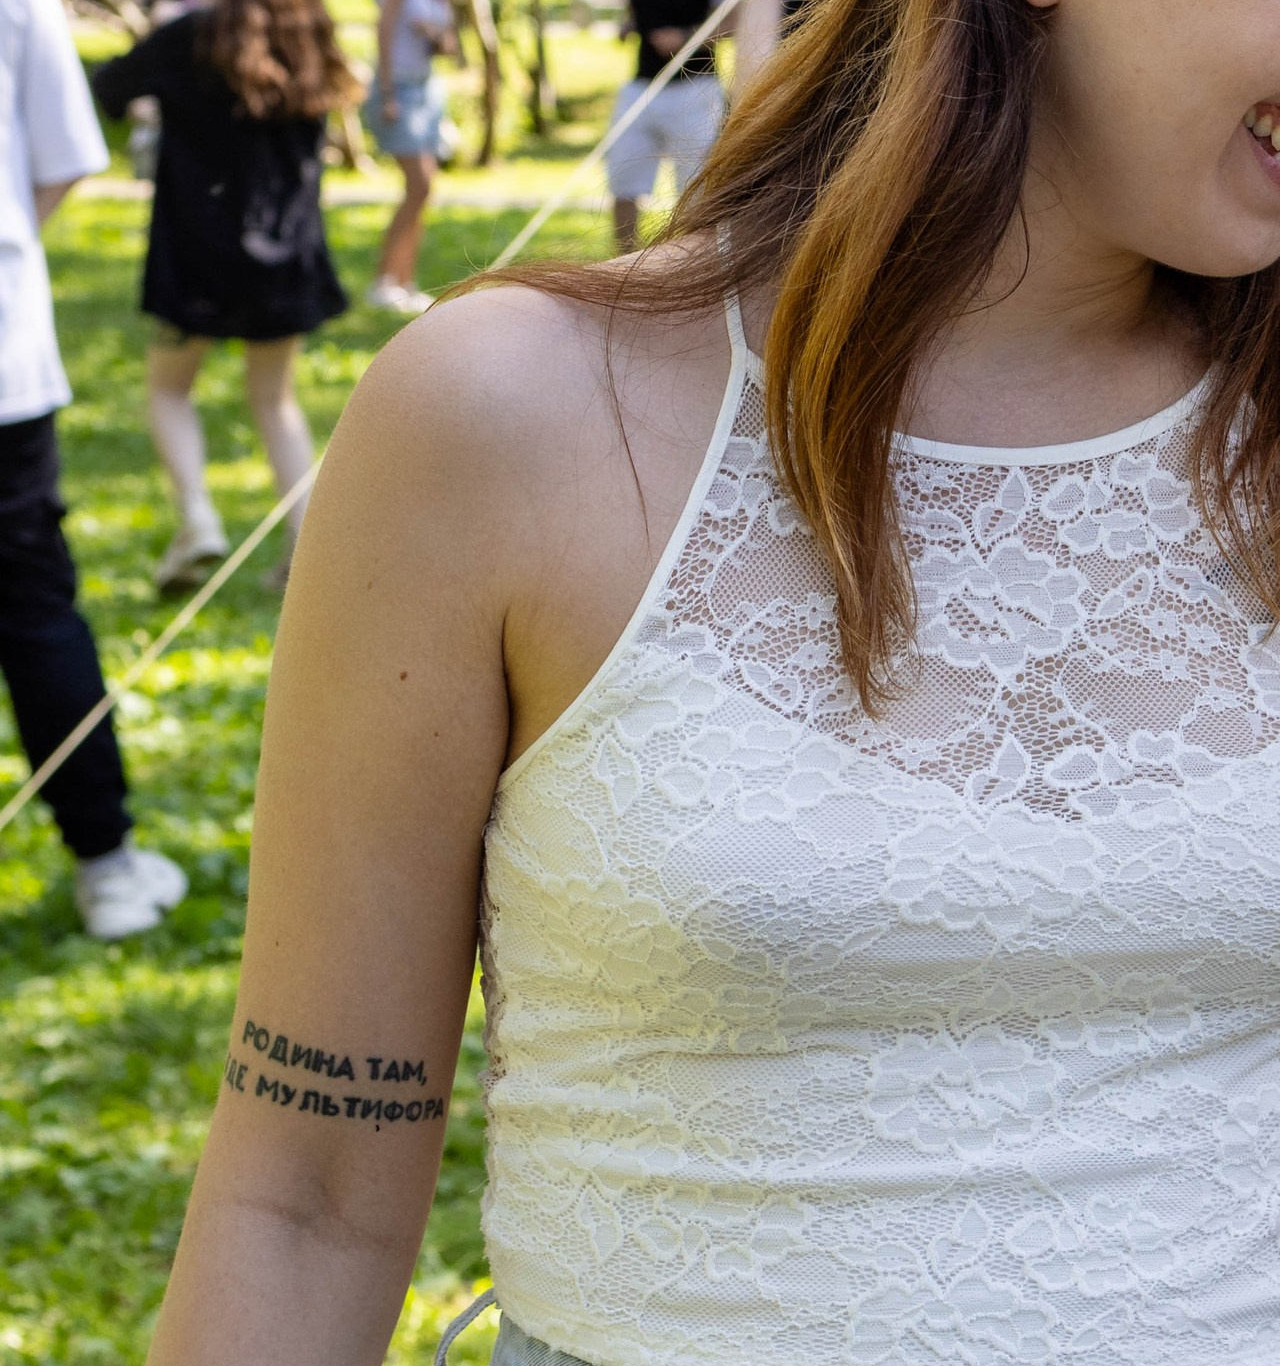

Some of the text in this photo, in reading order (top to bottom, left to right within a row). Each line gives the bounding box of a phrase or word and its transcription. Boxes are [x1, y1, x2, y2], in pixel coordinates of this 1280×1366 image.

[242, 1020, 428, 1087] РОДИНА ТАМ,
[225, 1053, 444, 1127] ДЕ МУЛЬТИФОРА
